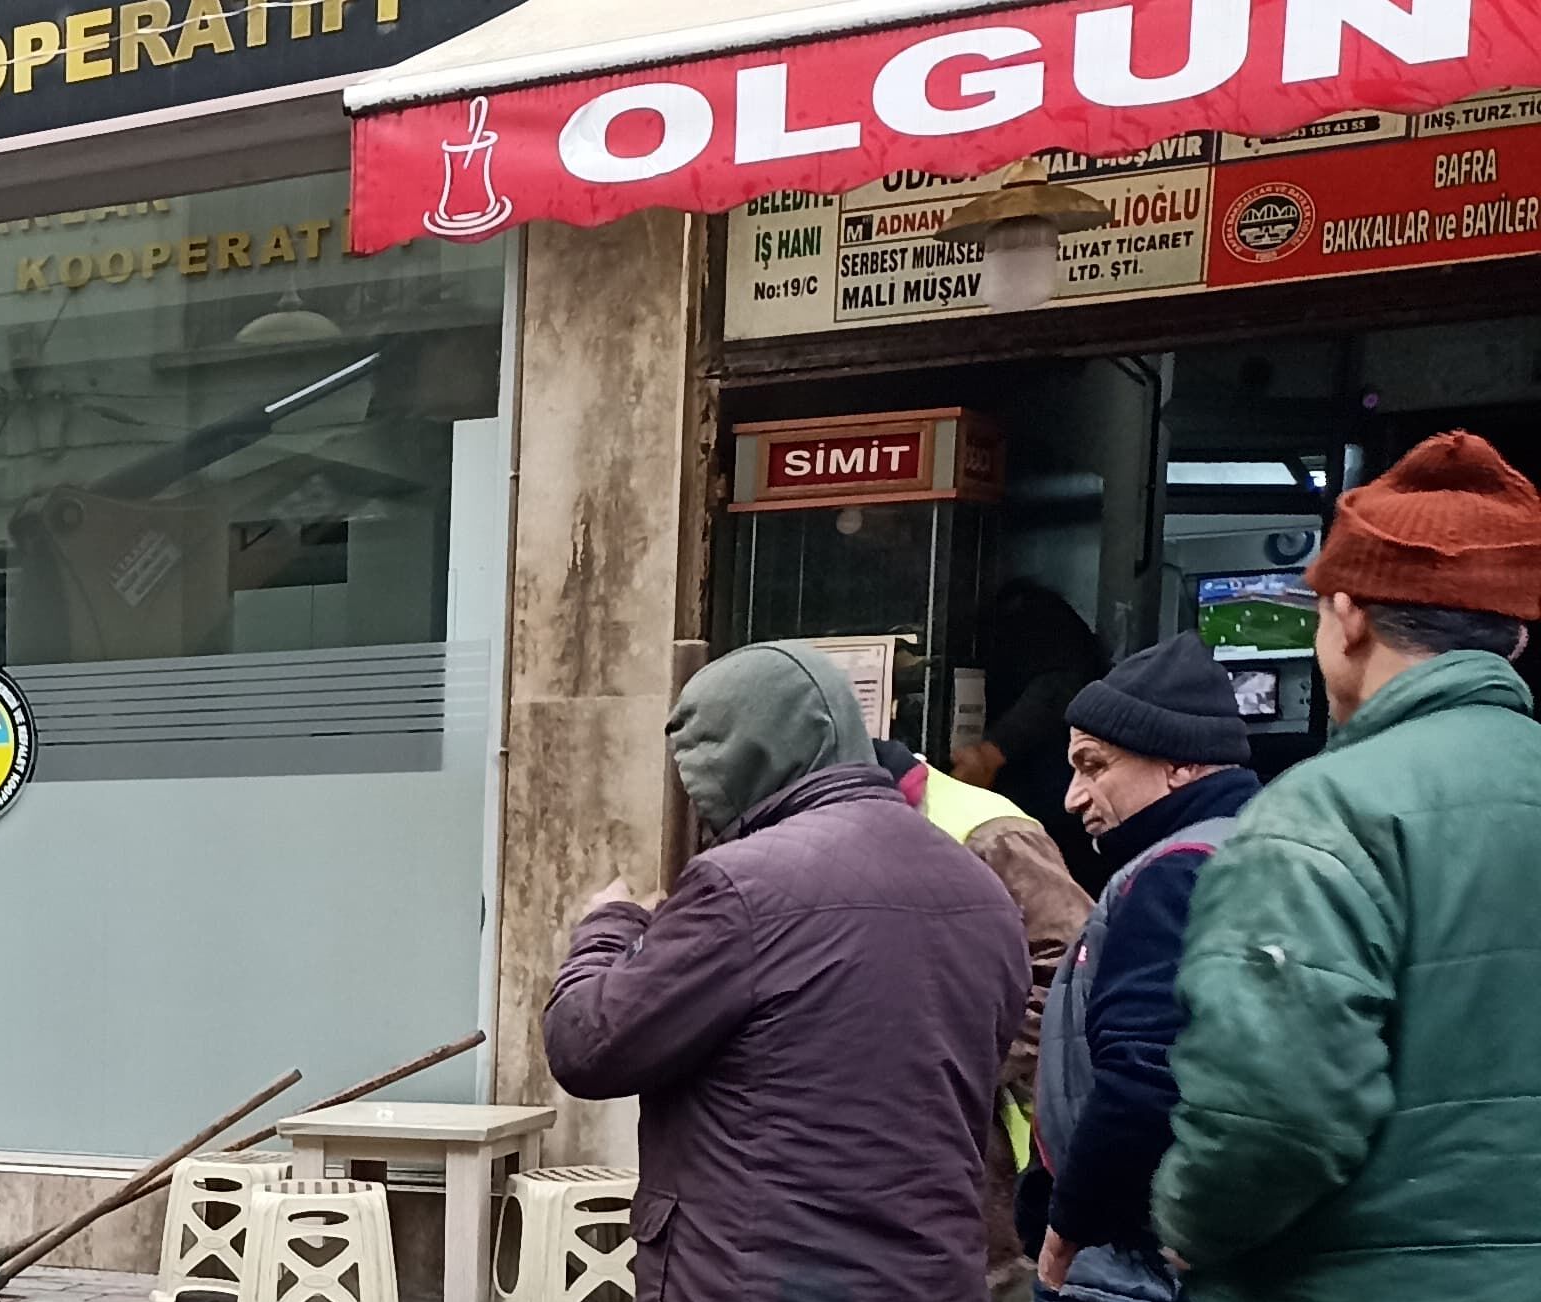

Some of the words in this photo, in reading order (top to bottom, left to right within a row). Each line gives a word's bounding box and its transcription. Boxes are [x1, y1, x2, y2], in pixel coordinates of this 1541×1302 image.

[557, 0, 1471, 184] OLGUN
[1310, 122, 1331, 136] 155
[1333, 120, 1348, 133] 43
[1351, 119, 1366, 131] 55
[1434, 148, 1497, 188] BAFRA
[875, 209, 945, 237] ADNAN
[1105, 183, 1201, 230] LİOĞLU
[18, 207, 353, 293] KOOPERATİ
[755, 224, 772, 270] İŞ
[778, 225, 822, 261] HANI
[1116, 230, 1195, 255] TİCARET
[1322, 209, 1429, 254] BAKKALLAR
[1435, 214, 1456, 241] ve
[840, 247, 908, 278] SERBEST
[1068, 263, 1105, 282] LTD.
[1110, 254, 1144, 282] ŞTİ.
[754, 275, 818, 301] No:19/C
[842, 275, 896, 311] MALİ
[903, 270, 982, 307] MÜŞAV
[784, 440, 910, 476] SİMİT
